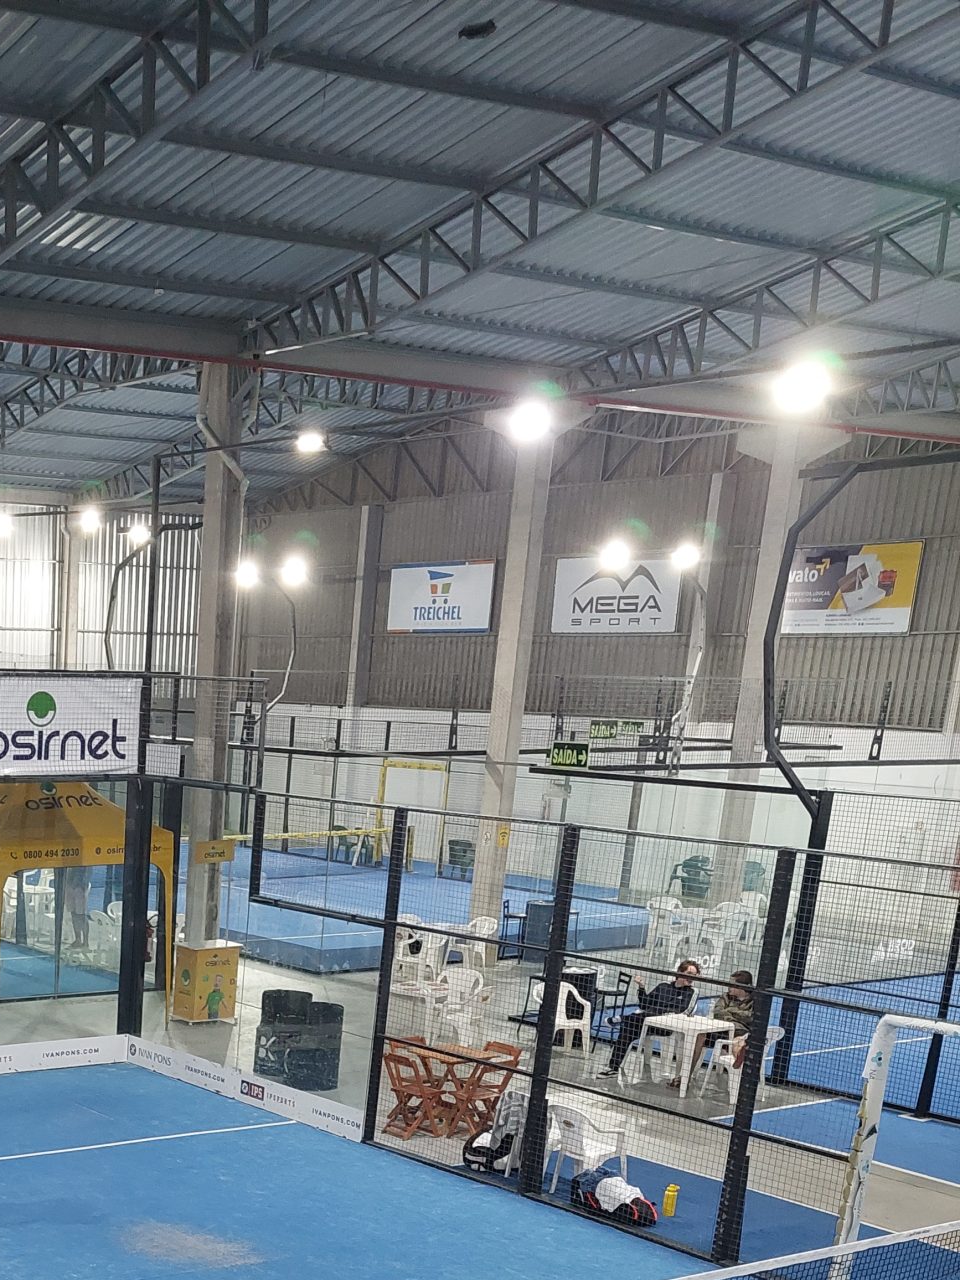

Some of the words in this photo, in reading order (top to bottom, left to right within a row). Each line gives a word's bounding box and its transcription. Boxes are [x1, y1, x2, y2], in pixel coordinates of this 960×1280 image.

[572, 595, 662, 614] MEGA
[413, 605, 462, 621] TREICHEL
[571, 617, 662, 626] SPORT
[552, 745, 578, 765] SAÍDA
[24, 791, 102, 811] osirnet
[23, 850, 43, 859] 0800
[44, 849, 59, 859] 494
[61, 848, 80, 858] 2030
[42, 1047, 100, 1059] IVANPONS.COM
[153, 1052, 172, 1067] PONS
[250, 1083, 264, 1099] IPS
[311, 1106, 362, 1130] IVANPONS.COM
